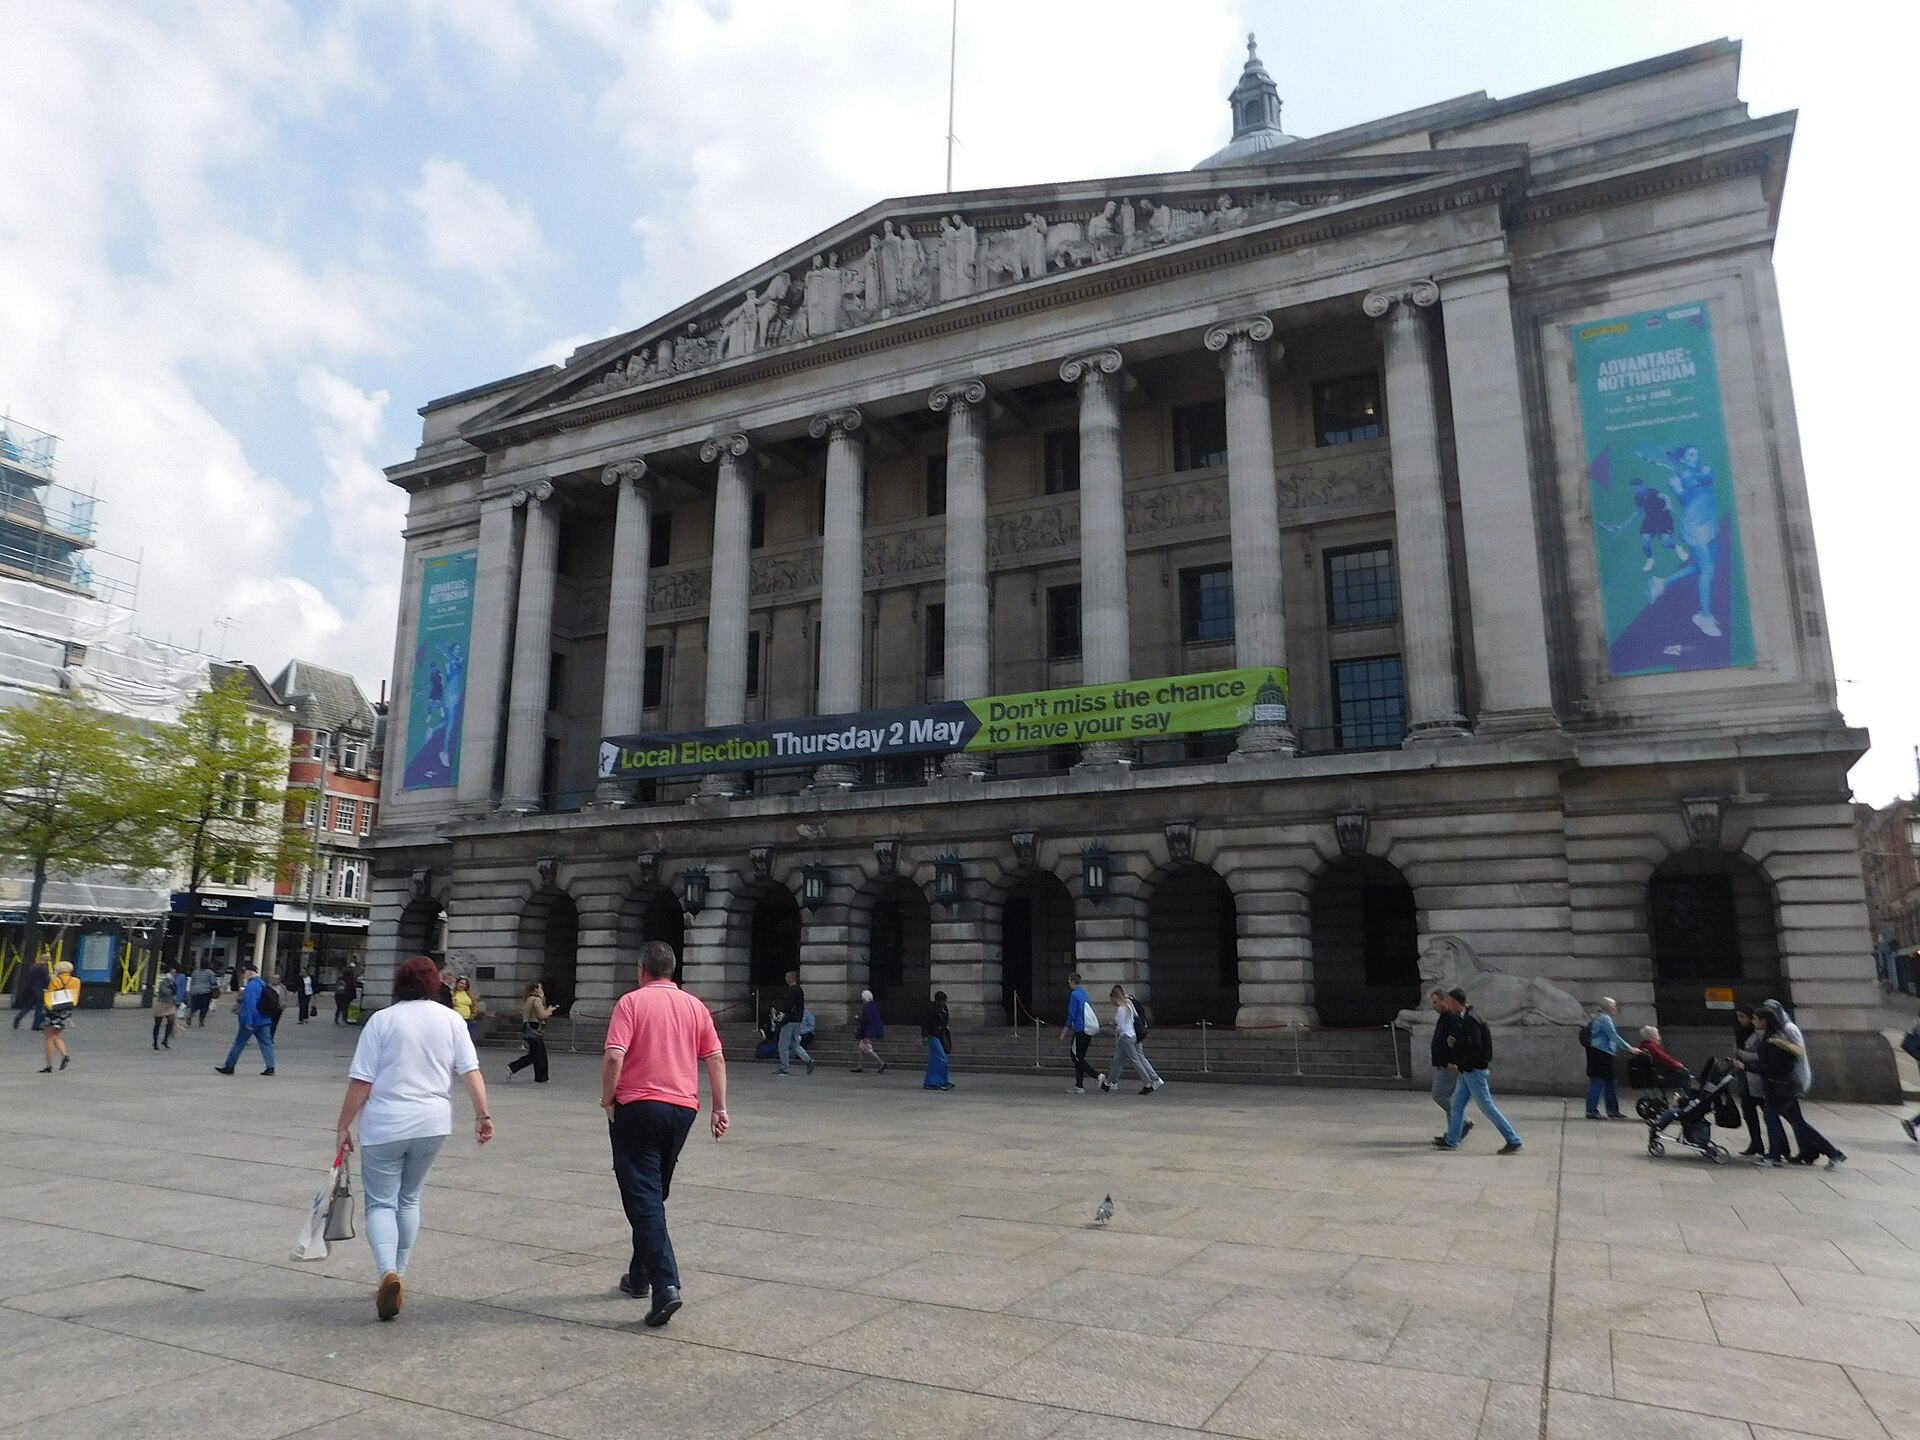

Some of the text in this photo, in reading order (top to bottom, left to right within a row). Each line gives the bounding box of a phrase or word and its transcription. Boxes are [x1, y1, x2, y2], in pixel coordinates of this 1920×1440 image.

[1597, 361, 1696, 392] NOTTINGHAM
[989, 679, 1246, 722] Don't miss the chance
[621, 718, 965, 769] Local Election Thursday 2 May
[988, 710, 1172, 744] to have your say
